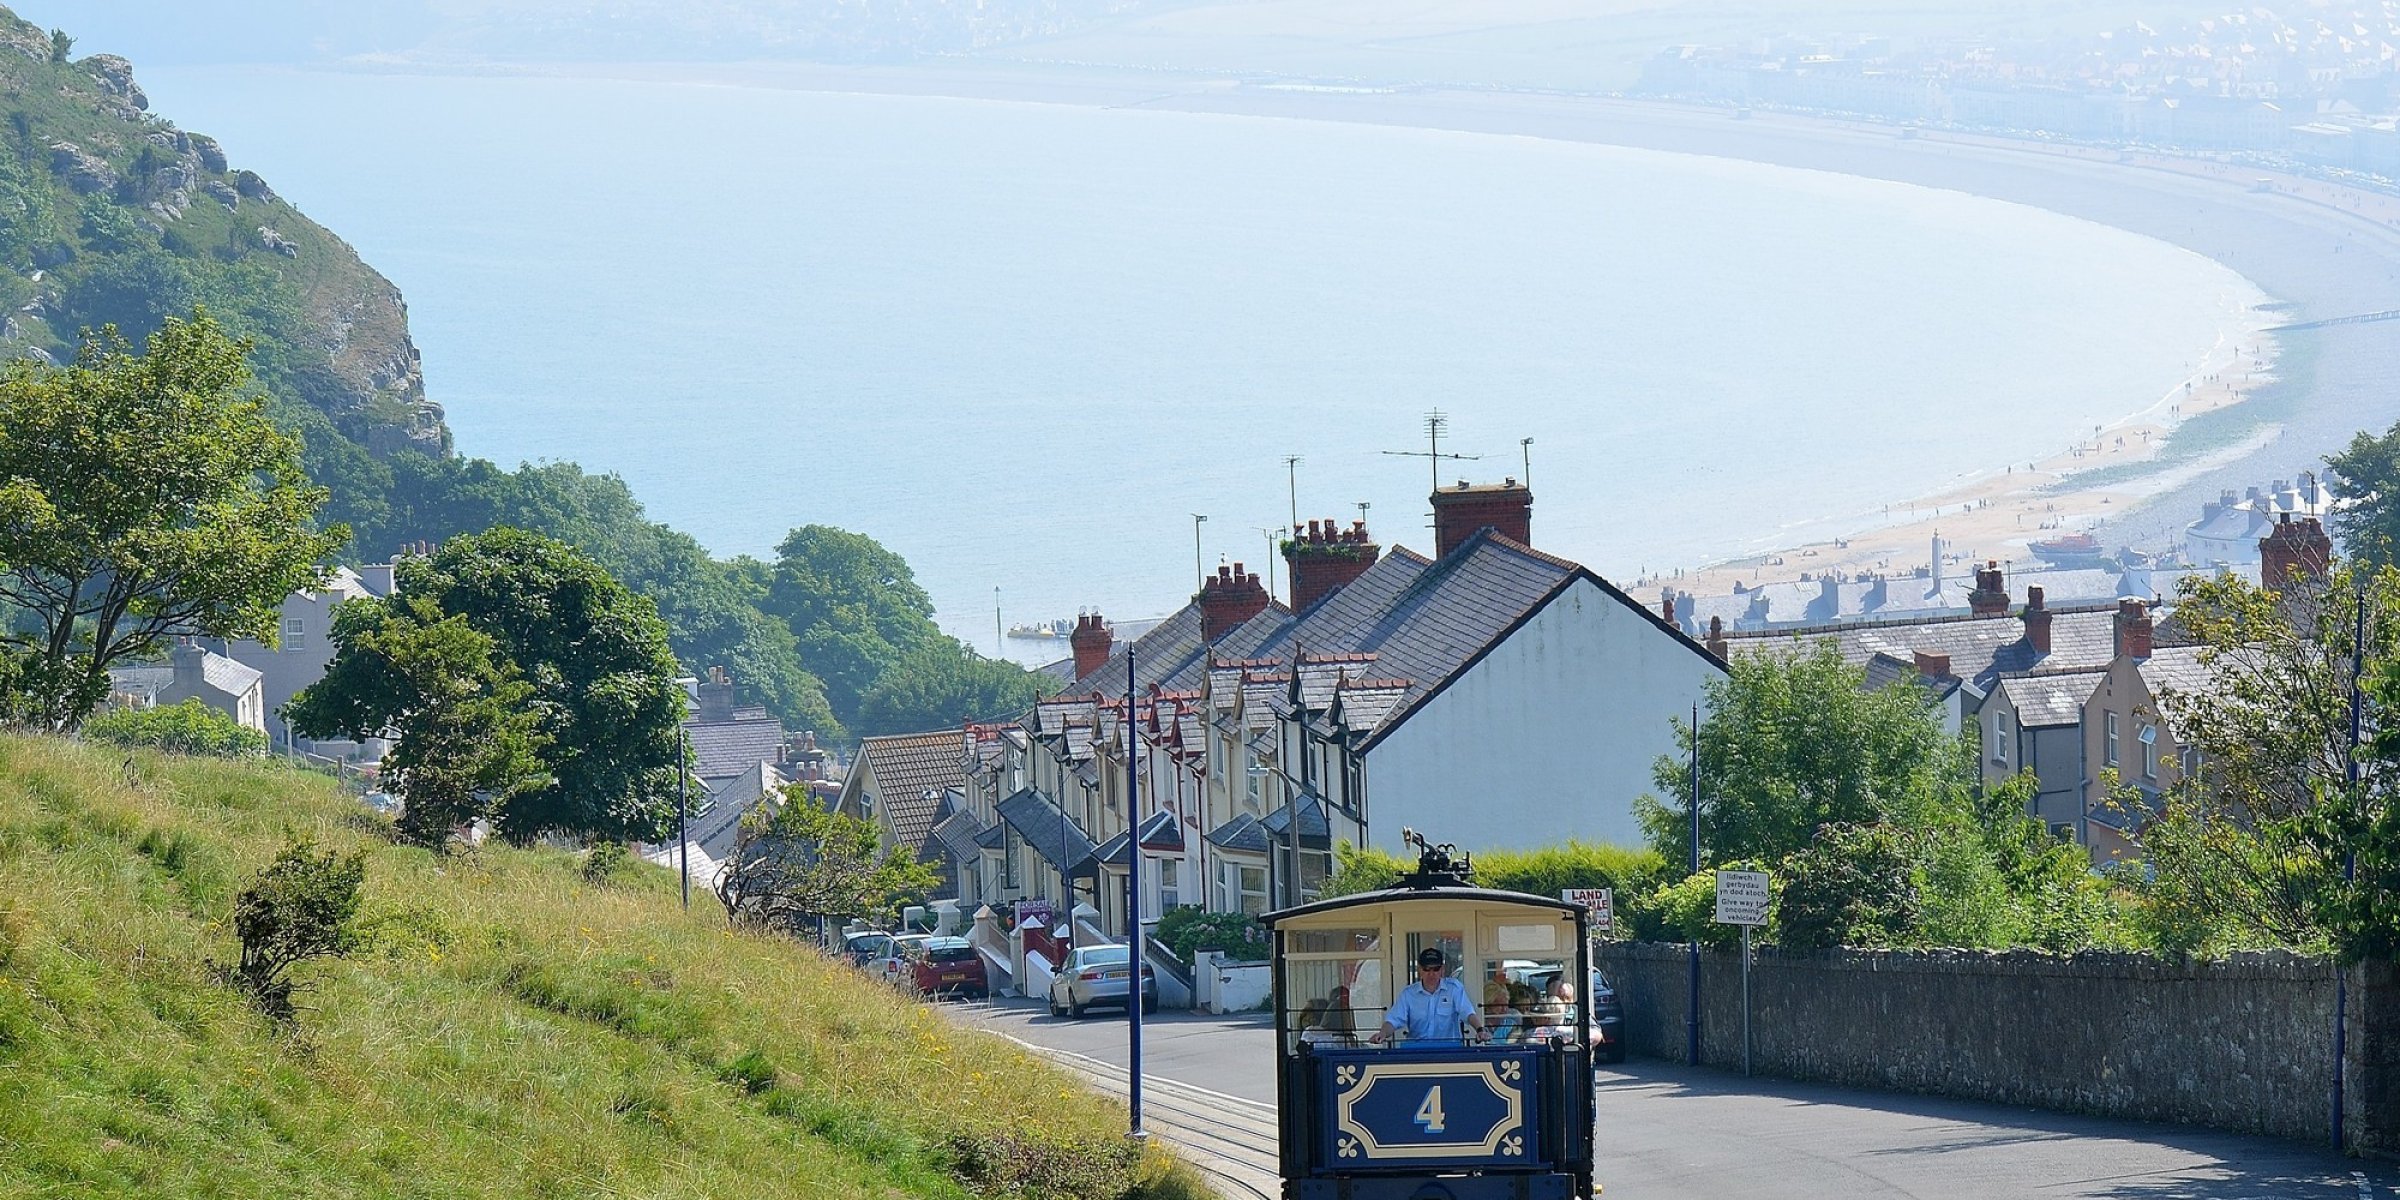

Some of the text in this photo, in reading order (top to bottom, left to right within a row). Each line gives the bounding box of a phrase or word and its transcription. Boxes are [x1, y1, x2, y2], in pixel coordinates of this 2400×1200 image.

[1726, 882, 1759, 890] gerbydau
[1572, 890, 1602, 900] LAND
[1730, 888, 1743, 896] dod
[1725, 907, 1759, 915] oncoming
[1413, 1085, 1446, 1134] 4
